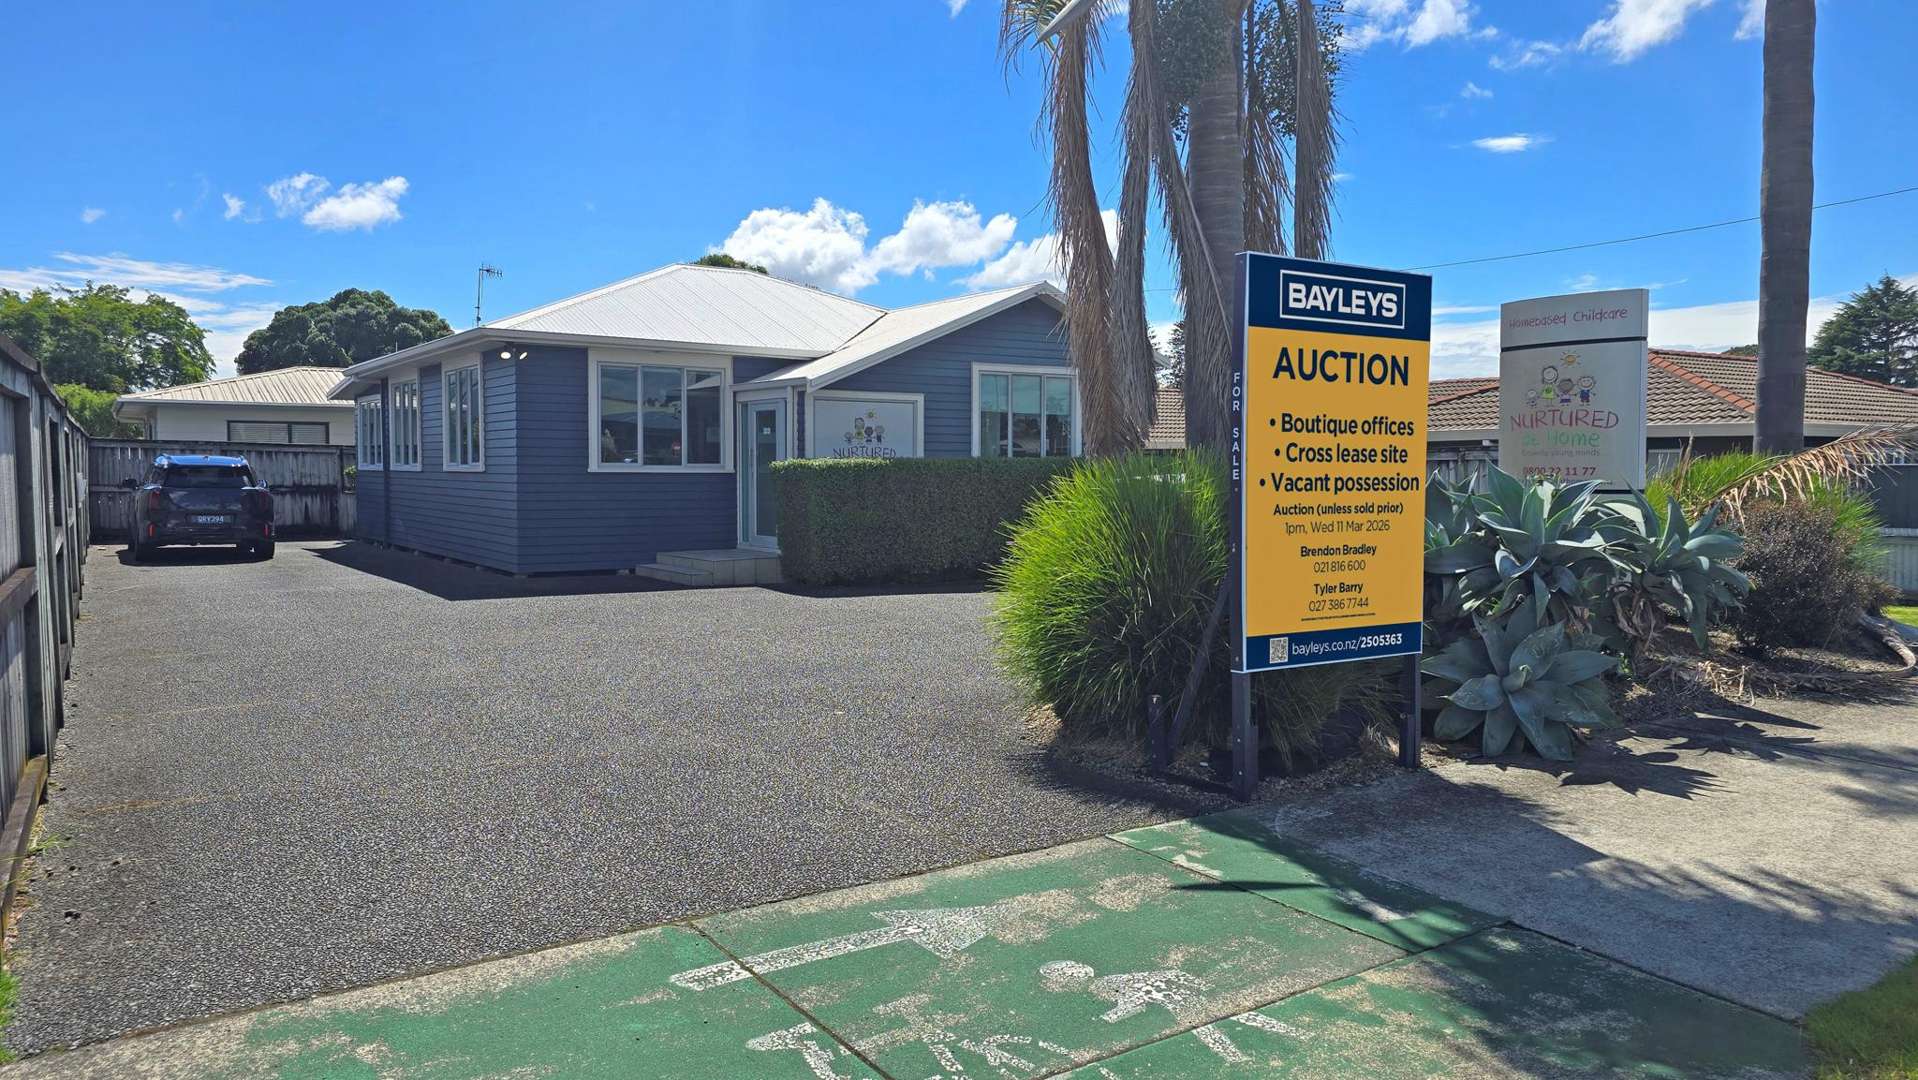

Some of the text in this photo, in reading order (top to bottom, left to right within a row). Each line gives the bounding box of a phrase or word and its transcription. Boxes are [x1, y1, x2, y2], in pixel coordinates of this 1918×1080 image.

[1288, 282, 1398, 318] BAYLEYS
[1573, 308, 1629, 324] Childcare
[1272, 347, 1409, 386] AUCTION
[1231, 372, 1241, 480] FOR SALE
[1281, 413, 1414, 437] Boutique offices
[1510, 409, 1620, 431] NURTURED
[1547, 430, 1601, 448] Home
[1286, 442, 1408, 464] Cross lease site
[1565, 467, 1577, 476] 11
[1582, 467, 1597, 476] 77
[1271, 473, 1420, 495] Vacant possession
[1273, 502, 1404, 516] Auction (unless sold prior)
[1285, 519, 1390, 536] 1pm, Wed 11 Mar 2026
[1300, 543, 1377, 557] Brendon Bradley
[1313, 560, 1366, 573] 021 816 600
[1314, 582, 1364, 597] Tyler Barry
[1308, 597, 1369, 612] 027 386 7744
[1292, 633, 1403, 655] bayleys.co.nz/2505363
